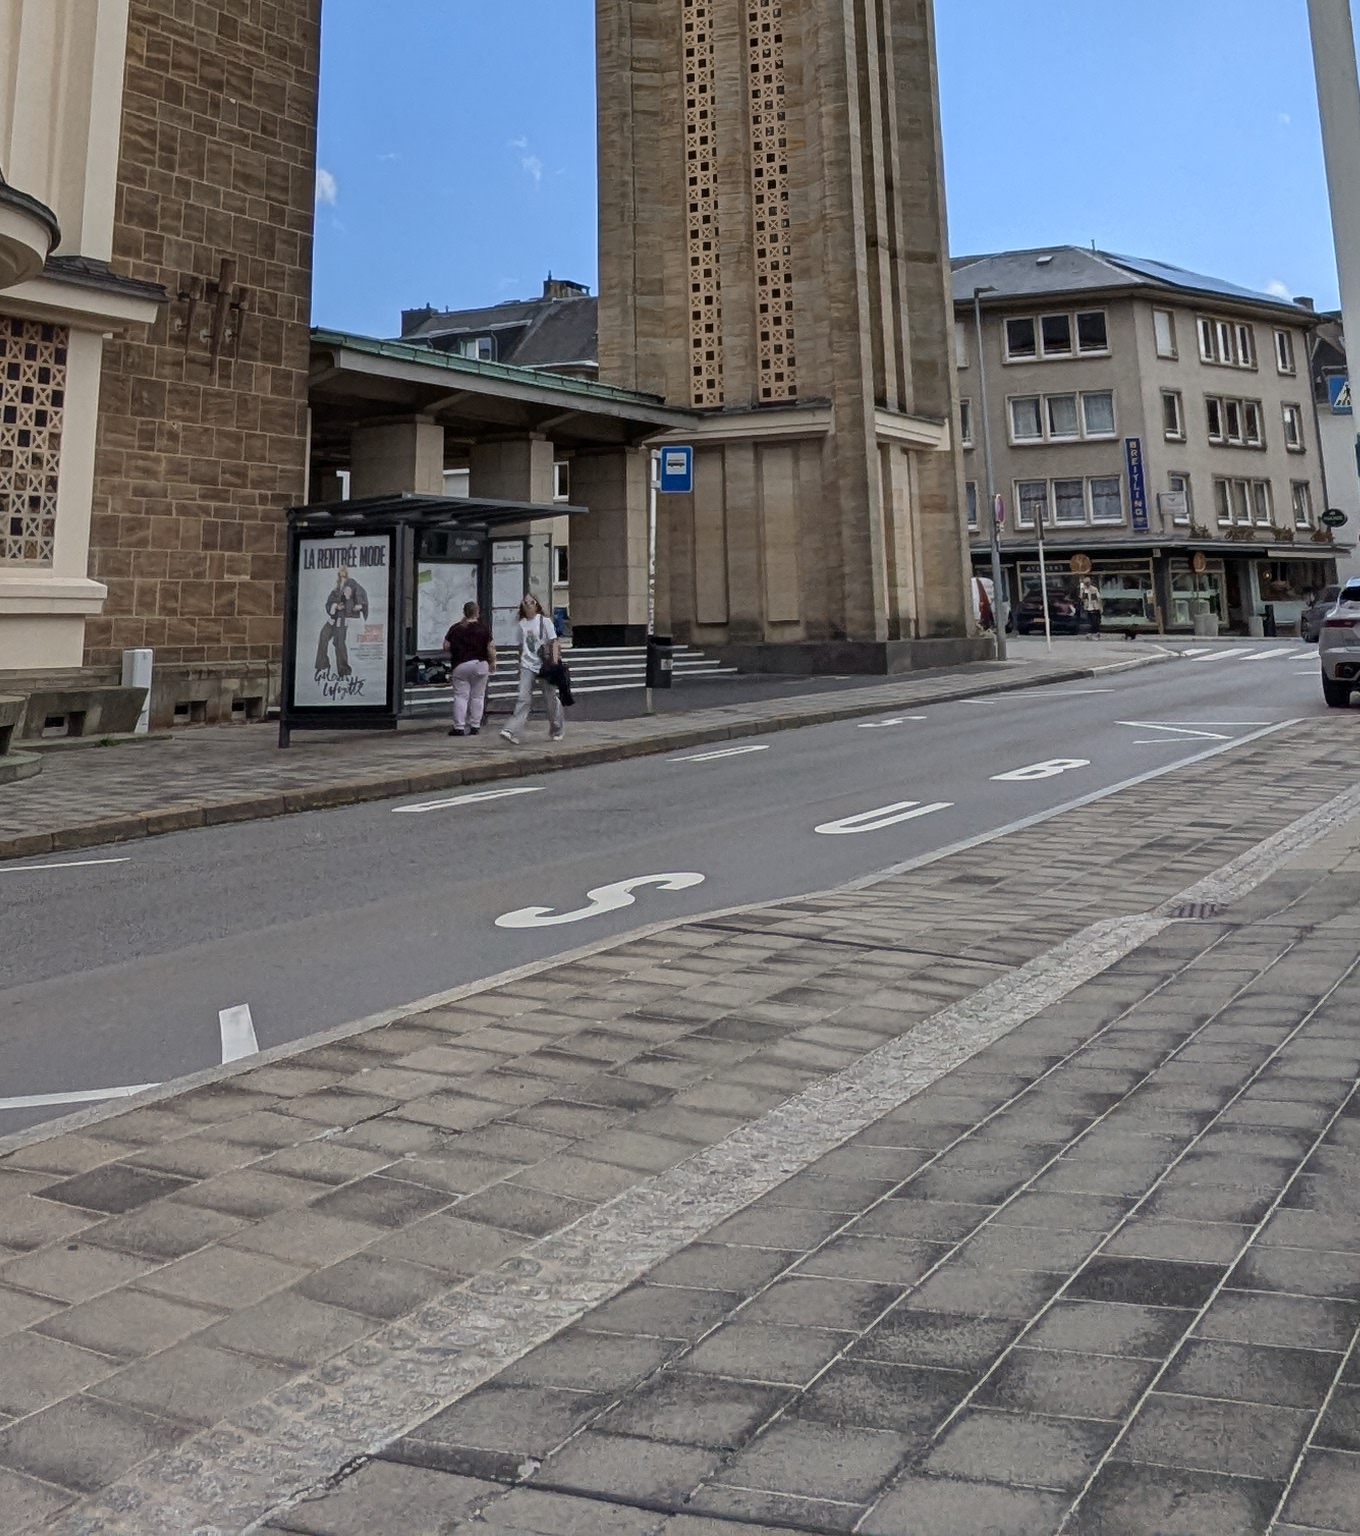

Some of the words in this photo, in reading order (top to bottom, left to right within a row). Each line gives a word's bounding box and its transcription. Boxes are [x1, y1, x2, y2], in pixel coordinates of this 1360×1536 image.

[1129, 441, 1143, 516] BREITLING
[303, 548, 315, 570] LA
[317, 544, 357, 569] RENTRÉE
[359, 545, 386, 567] MODE
